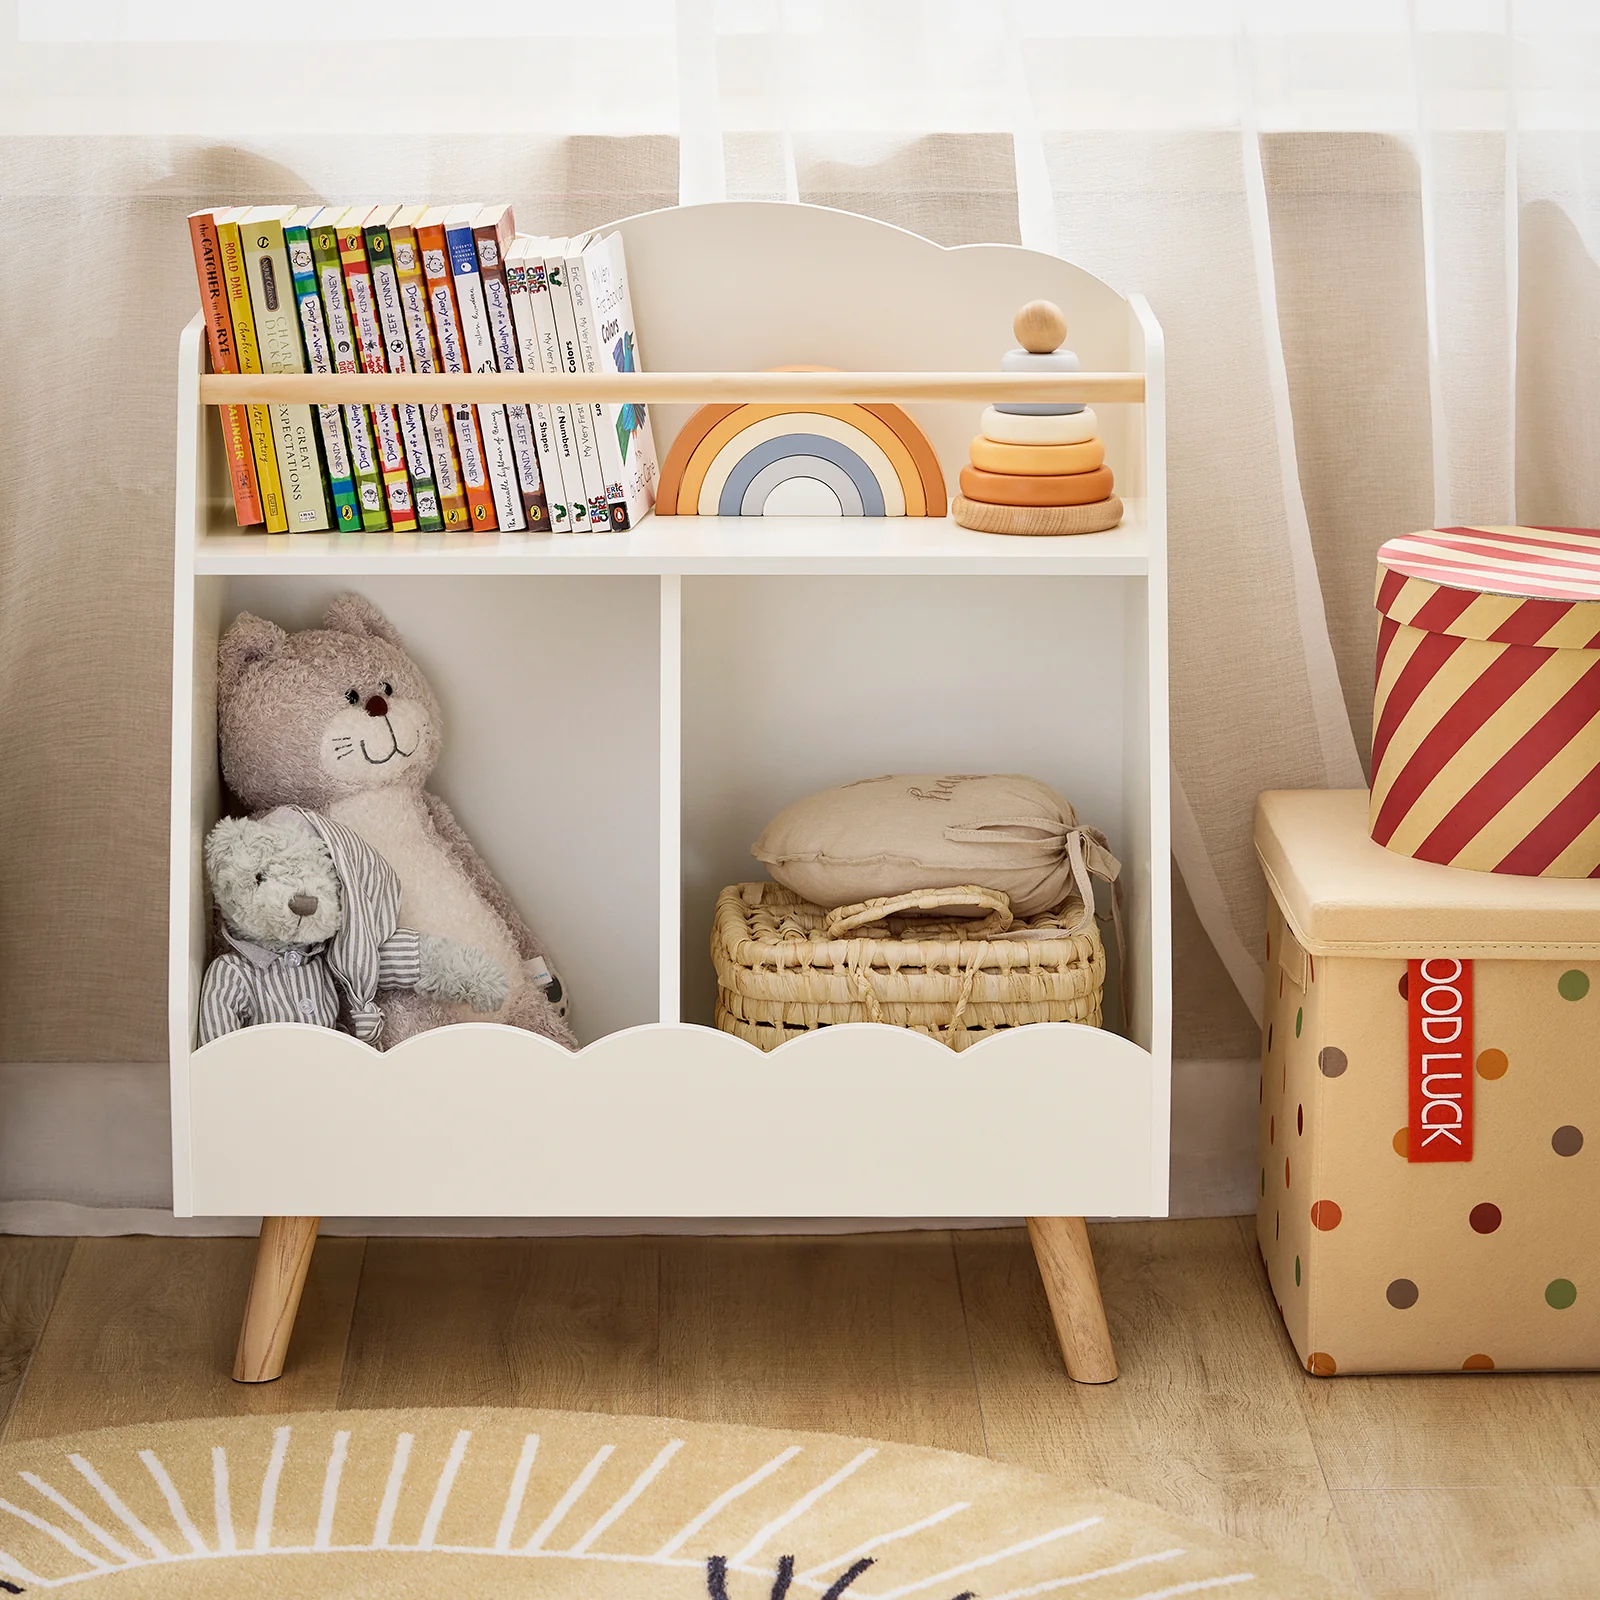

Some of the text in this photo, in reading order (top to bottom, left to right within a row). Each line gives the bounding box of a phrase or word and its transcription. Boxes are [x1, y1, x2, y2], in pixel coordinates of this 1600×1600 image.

[225, 242, 243, 301] ROALD DAHL
[507, 267, 521, 295] CARLE
[526, 267, 541, 295] CARLE
[199, 223, 231, 357] the CATCHER in the RYE
[489, 281, 503, 308] Diary
[571, 266, 584, 306] Eric Carle
[305, 300, 317, 324] Diary
[328, 274, 345, 335] JEFF KINNEY
[355, 279, 373, 337] JEFF KINNEY
[380, 271, 398, 335] JEFF KINNEY
[435, 290, 449, 317] Diary
[497, 310, 505, 318] of
[405, 285, 420, 312] Diary
[415, 328, 426, 358] Wimpy
[580, 317, 587, 328] My
[601, 318, 620, 344] Colors
[276, 316, 296, 374] CHARL
[444, 333, 455, 362] Wimpy
[498, 325, 509, 355] Wimpy
[544, 332, 552, 345] My
[581, 328, 589, 344] Very
[313, 337, 323, 364] Wimpy
[503, 355, 515, 370] Kid
[525, 338, 535, 371] My Very
[546, 345, 555, 365] Very
[566, 341, 576, 373] Colors
[317, 364, 328, 373] Ki
[449, 363, 461, 373] Ki
[238, 321, 253, 354] Charlie
[255, 432, 269, 465] Factory
[351, 404, 361, 428] Wimp
[379, 404, 389, 422] Wim
[537, 411, 546, 420] of
[595, 403, 603, 417] ors
[539, 421, 550, 453] Shapes
[556, 405, 570, 457] of Numbers
[578, 406, 593, 457] My Very First
[296, 426, 311, 470] GREAT
[328, 419, 344, 475] JEFF KINNEY
[357, 444, 371, 470] Diary
[384, 438, 397, 462] Diary
[433, 426, 452, 491] JEFF KINNEY
[461, 422, 479, 484] JEFF KINNEY
[516, 423, 534, 487] JEFF KINNEY
[412, 449, 426, 476] Diary
[491, 409, 516, 529] The Unbearable Lightness of Being
[606, 485, 623, 494] ERIC
[607, 491, 624, 500] CARLE
[1420, 958, 1463, 1147] OOD LUCK
